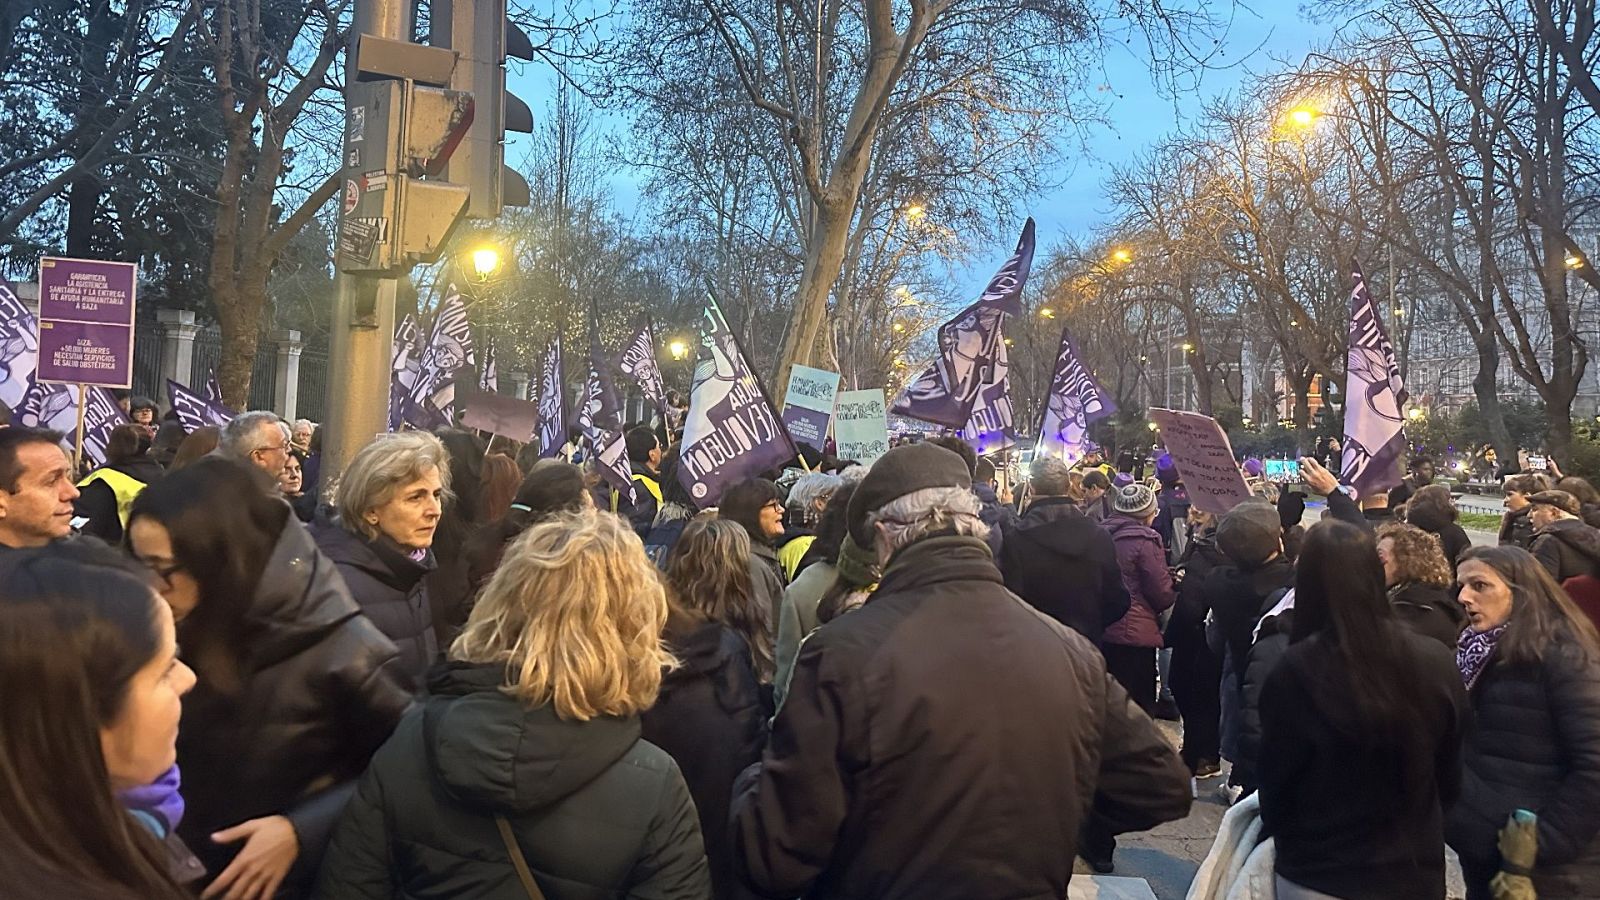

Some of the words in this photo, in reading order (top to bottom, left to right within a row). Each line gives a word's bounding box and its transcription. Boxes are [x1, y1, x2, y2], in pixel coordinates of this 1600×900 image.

[70, 273, 106, 282] GARANTICEN
[49, 286, 82, 295] SANITARIA
[97, 289, 126, 298] ENTREGA
[50, 293, 59, 301] DE
[60, 294, 81, 302] AYUDA
[81, 296, 125, 305] HUMANITARIA
[83, 347, 110, 355] MUJERES
[54, 352, 83, 360] NECESITAN
[84, 354, 116, 362] SERVICIOS
[61, 359, 79, 368] SALUD
